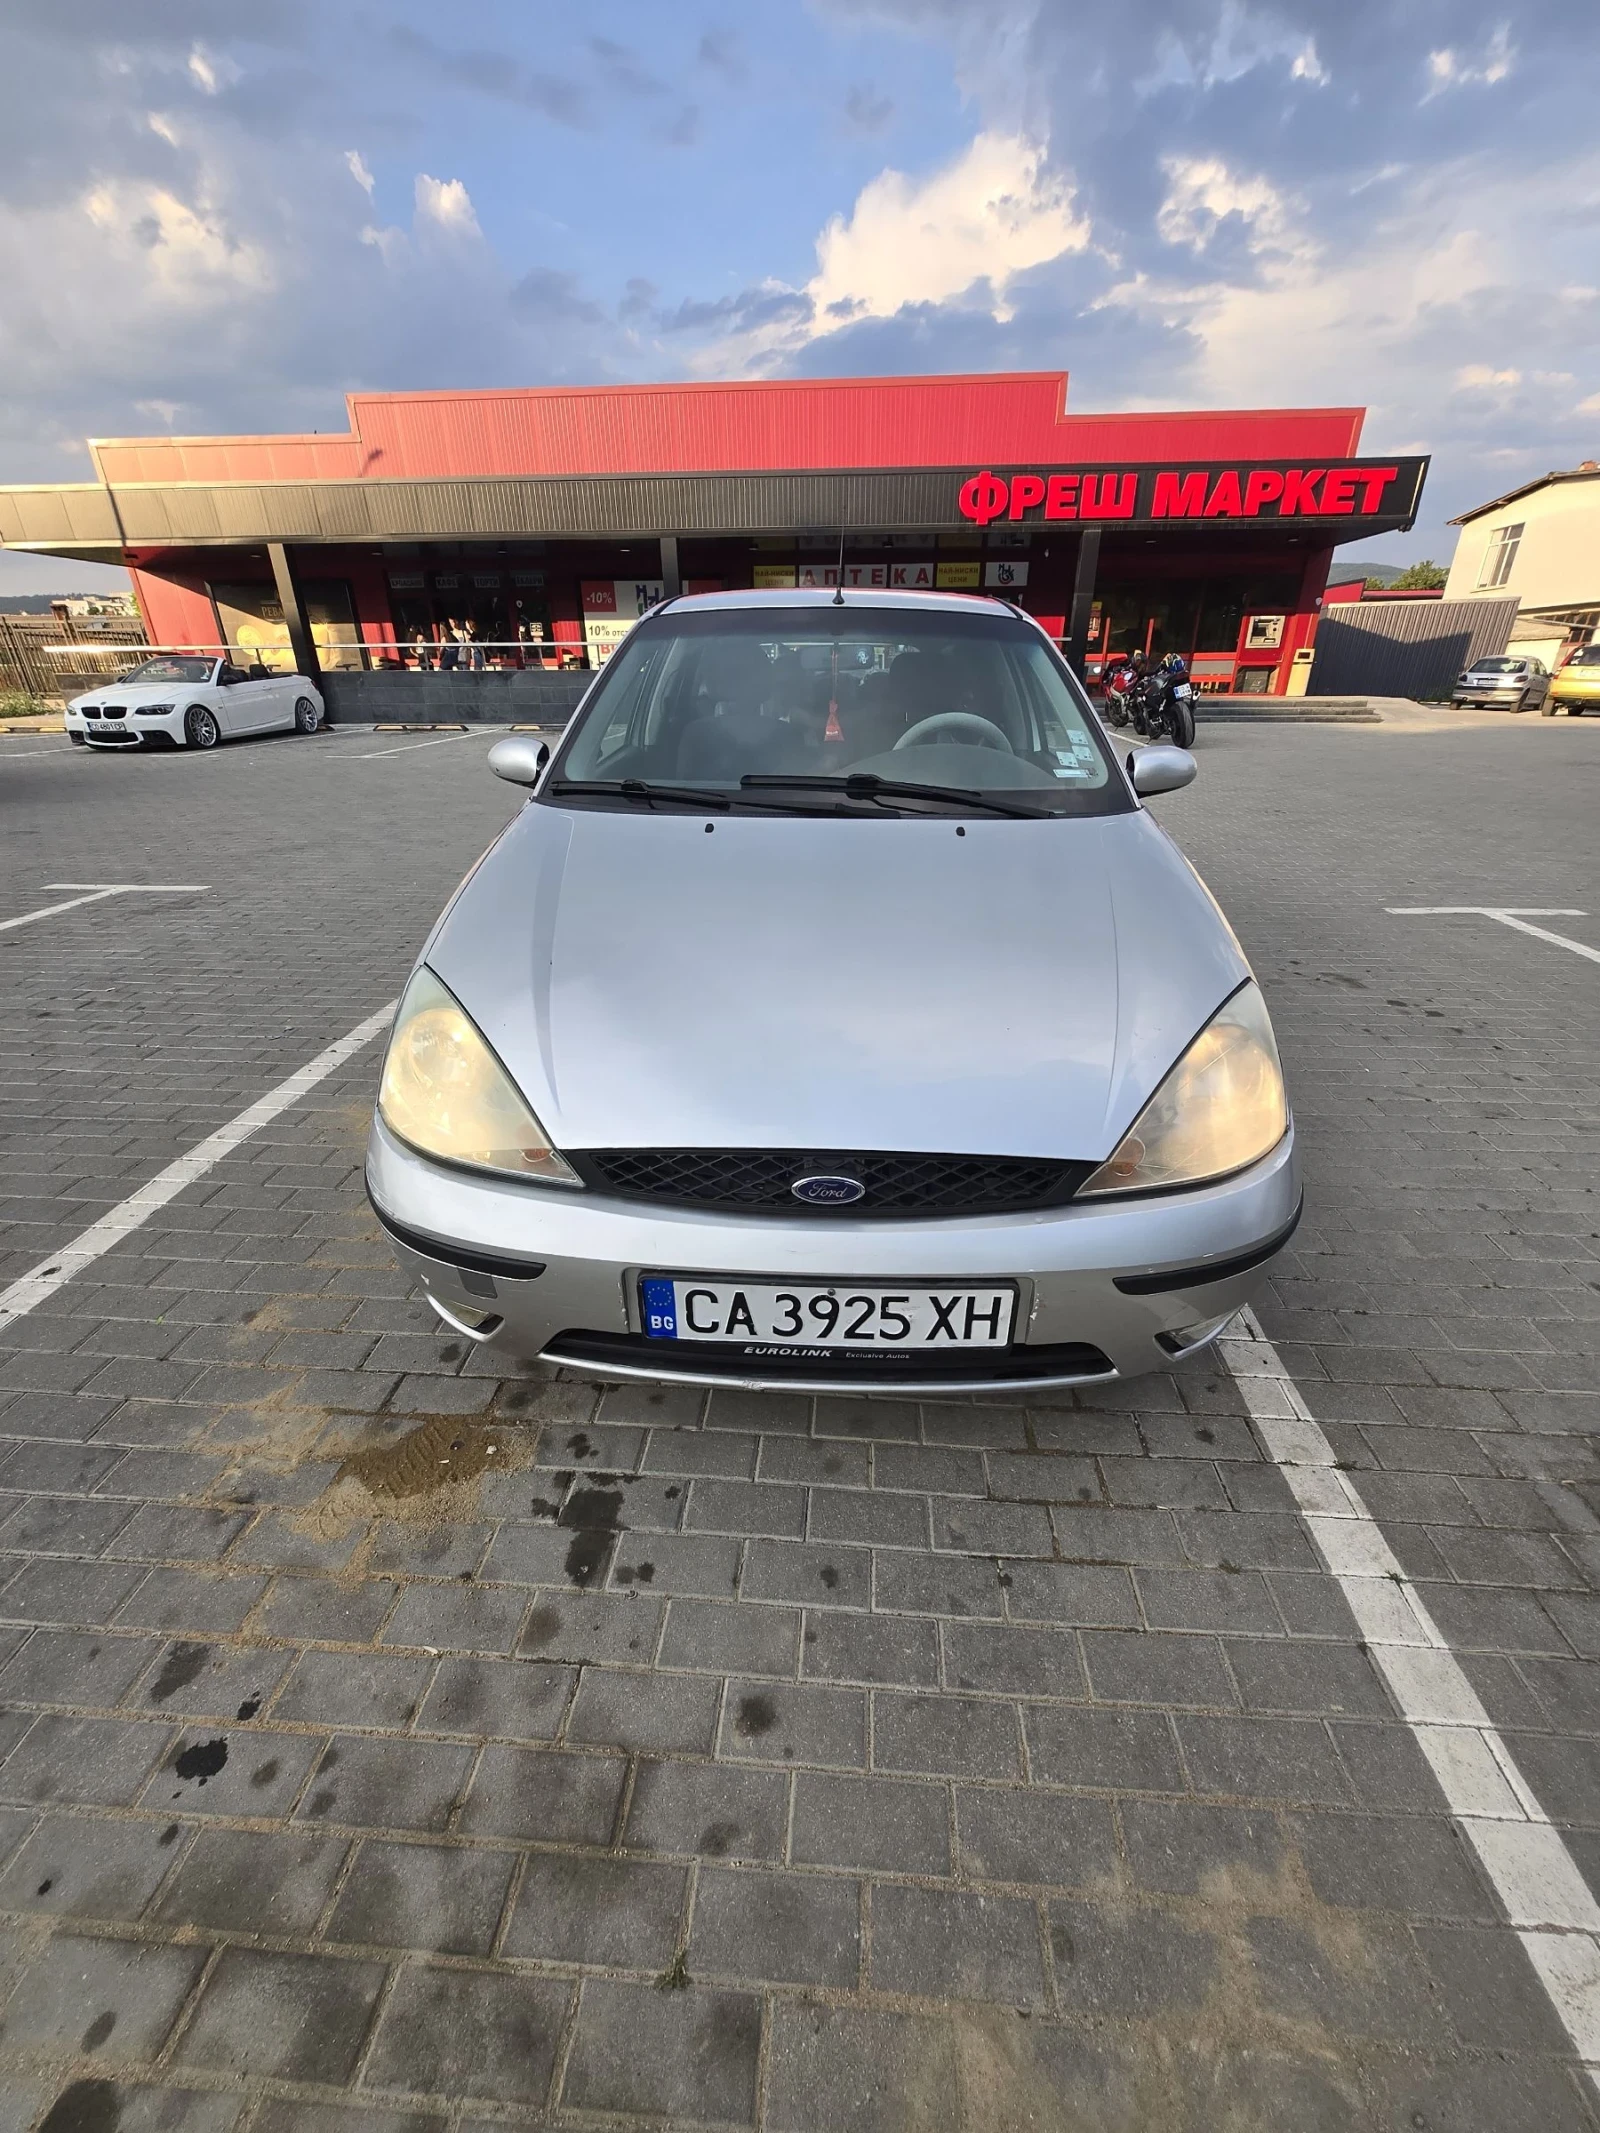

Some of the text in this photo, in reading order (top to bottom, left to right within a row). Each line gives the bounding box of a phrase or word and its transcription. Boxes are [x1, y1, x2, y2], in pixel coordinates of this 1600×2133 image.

[958, 467, 1399, 525] ФРЕШ МАРКЕТ
[803, 567, 930, 586] АПТЕКА
[948, 576, 968, 584] ЦЕНИ
[586, 592, 612, 604] -10%
[589, 625, 610, 636] 10%
[808, 1182, 848, 1198] Ford
[685, 1289, 1002, 1340] CA 3925 XH
[650, 1315, 674, 1330] BG
[744, 1346, 832, 1358] EUROLINK
[845, 1352, 884, 1360] Exclusive
